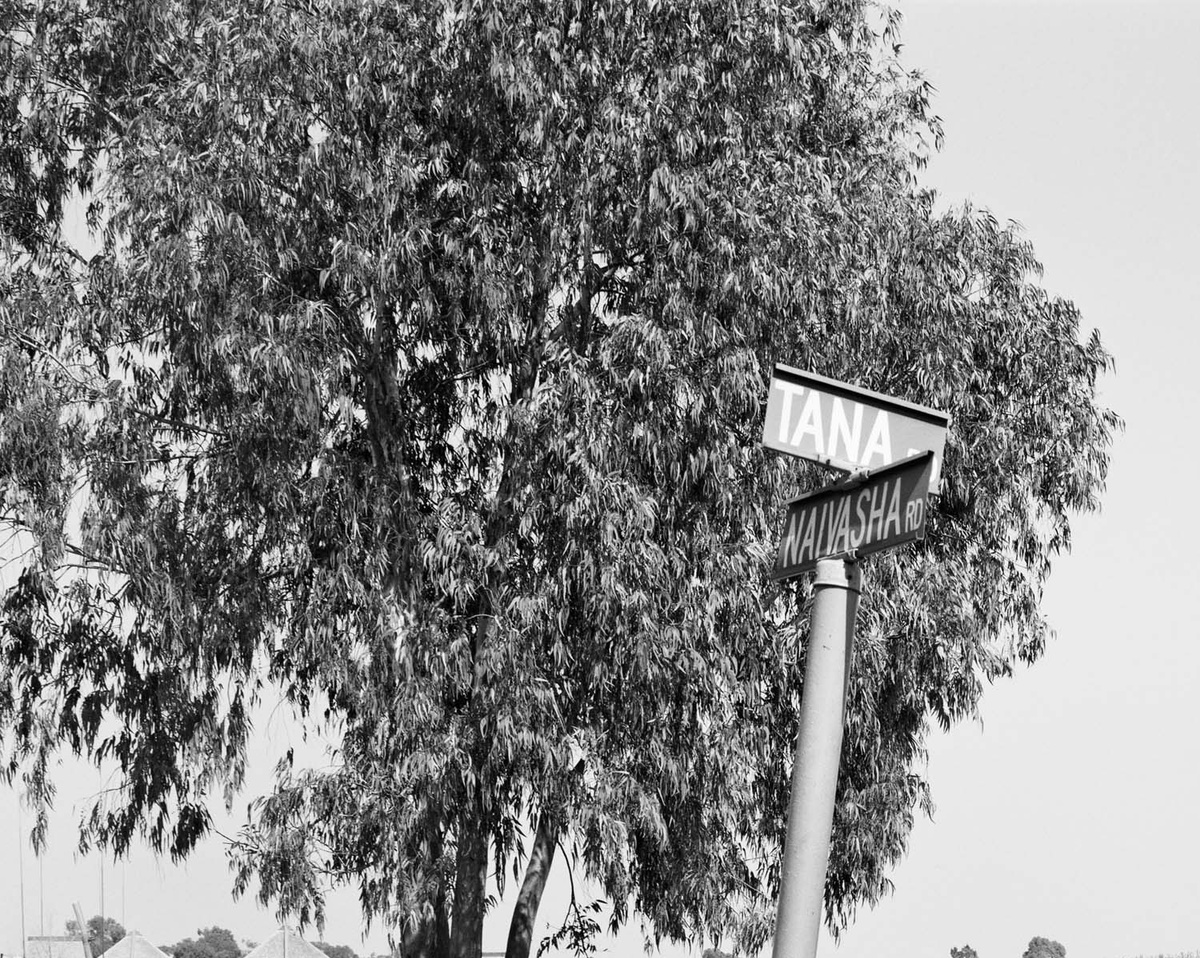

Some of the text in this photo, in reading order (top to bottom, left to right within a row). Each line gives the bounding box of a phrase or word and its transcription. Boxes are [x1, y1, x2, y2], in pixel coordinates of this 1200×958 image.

[775, 379, 893, 466] TANA
[783, 477, 923, 568] NAIVASHA RD
